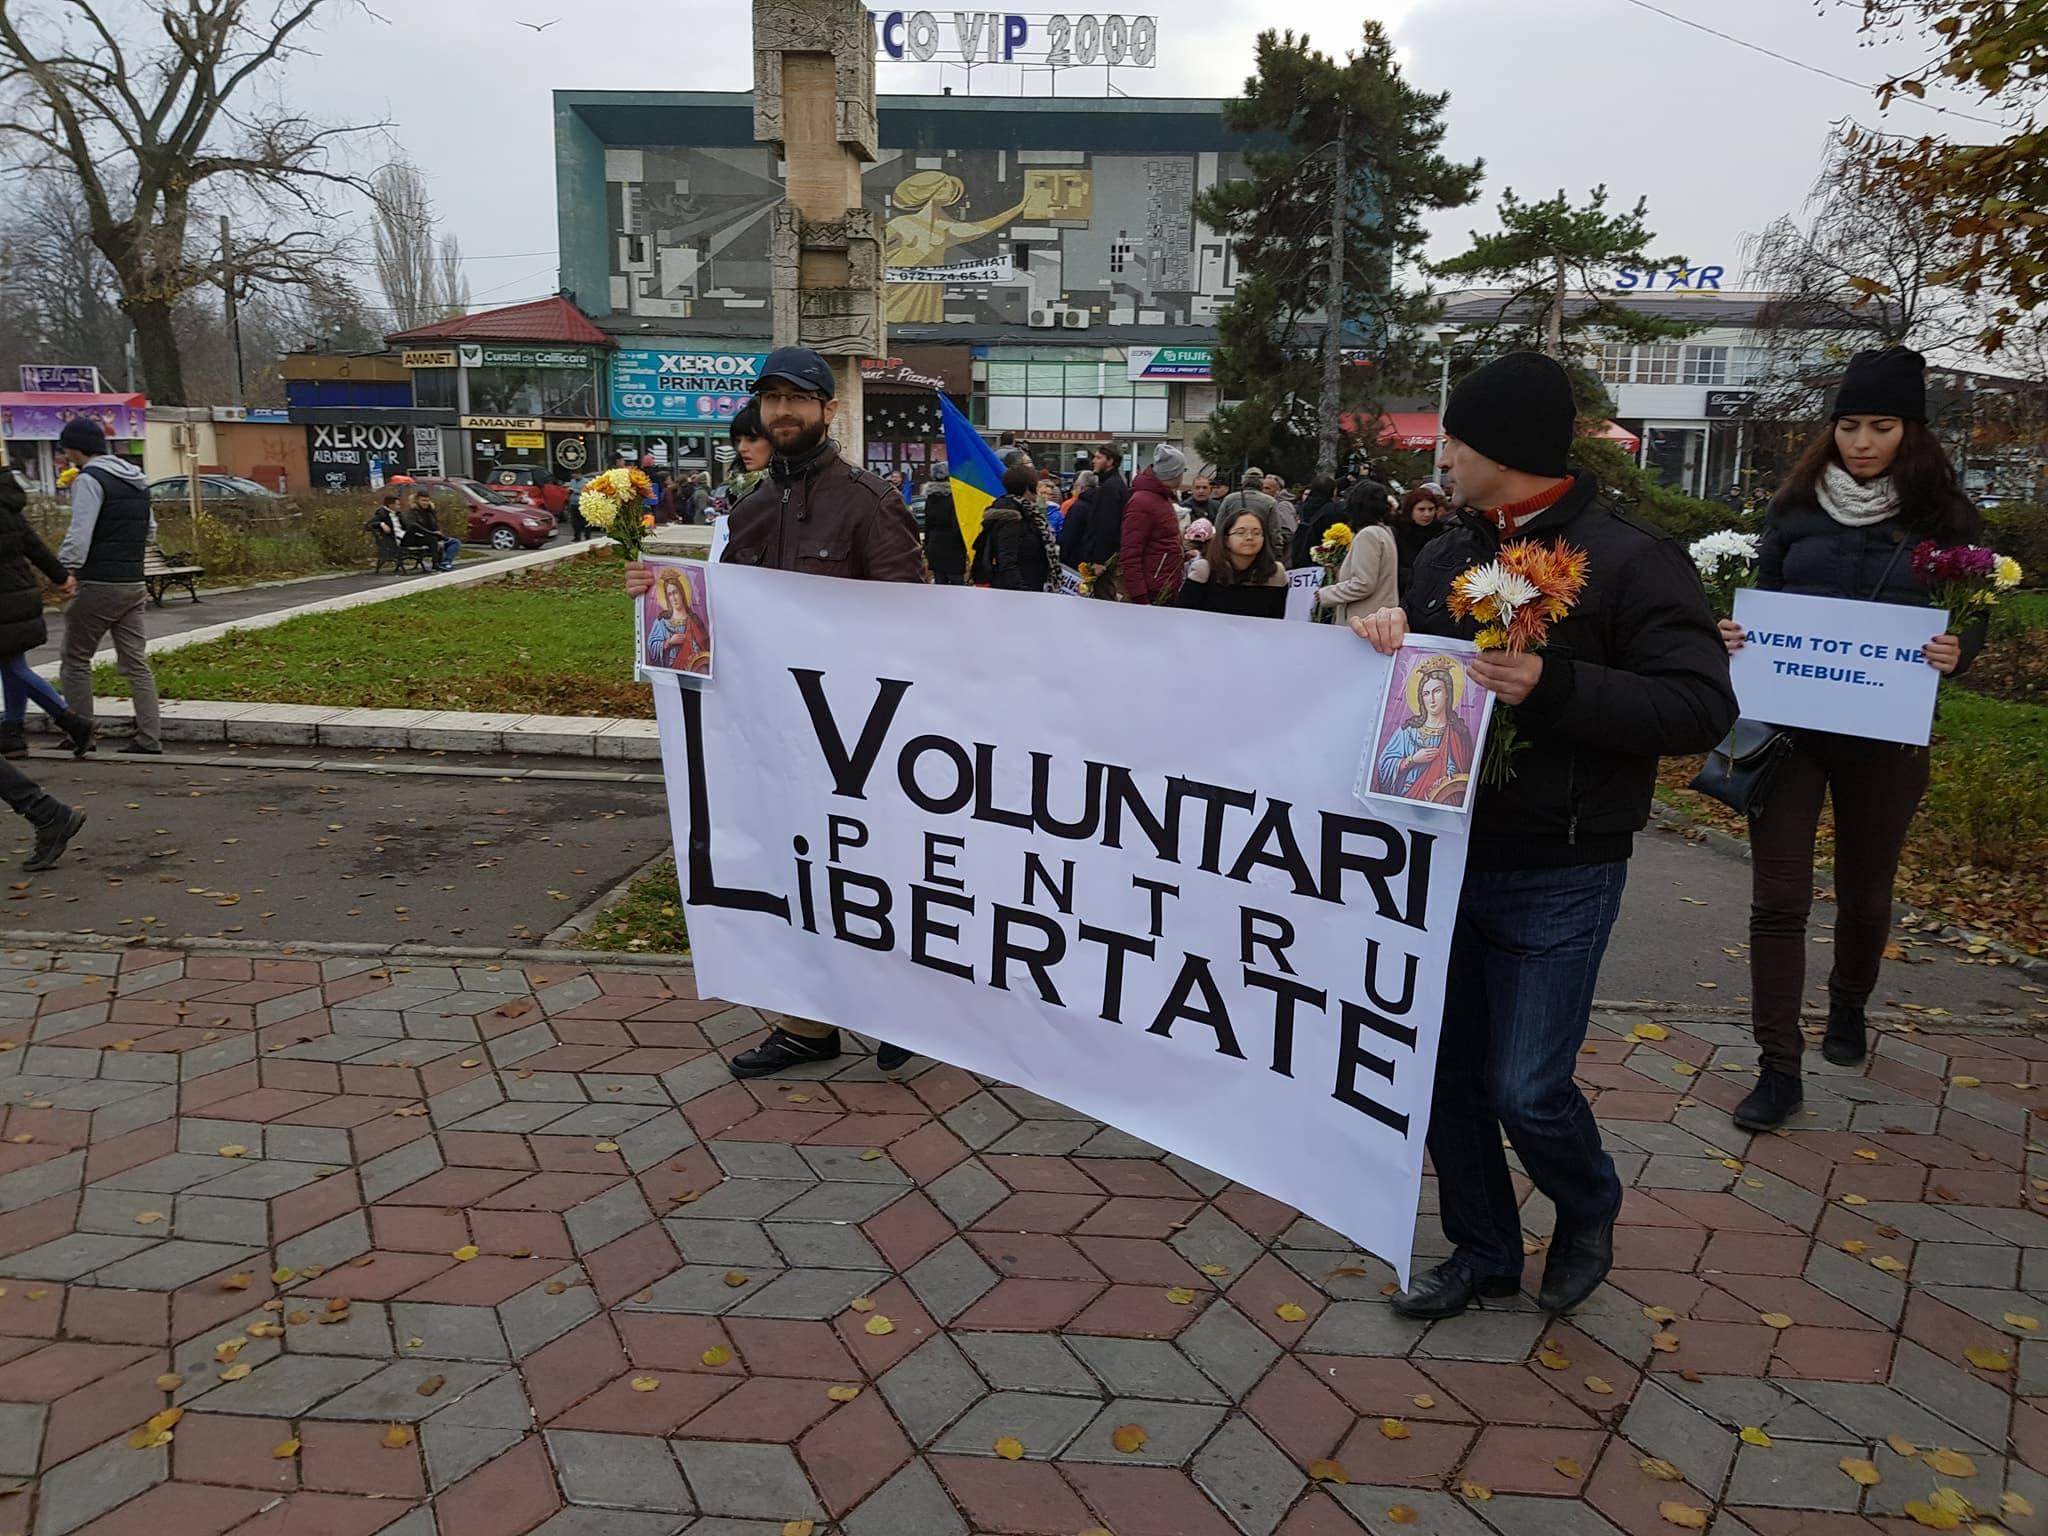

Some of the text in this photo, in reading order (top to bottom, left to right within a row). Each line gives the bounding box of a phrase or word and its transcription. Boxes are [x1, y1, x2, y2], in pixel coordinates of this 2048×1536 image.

[953, 12, 1027, 63] VIP
[1046, 14, 1156, 65] 2000
[405, 352, 452, 365] AMANET
[657, 354, 757, 376] XEROX
[897, 367, 945, 388] Pizzerie
[622, 394, 655, 408] ECO
[468, 418, 535, 428] AMANET
[313, 424, 405, 449] XEROX
[1023, 431, 1097, 440] PARFUMERIE
[1744, 630, 1926, 664] AVEM TOT CE NE
[1773, 660, 1884, 687] TREBUIE...
[788, 667, 1438, 932] VOLUNTARI
[827, 814, 1420, 1015] PENTRU
